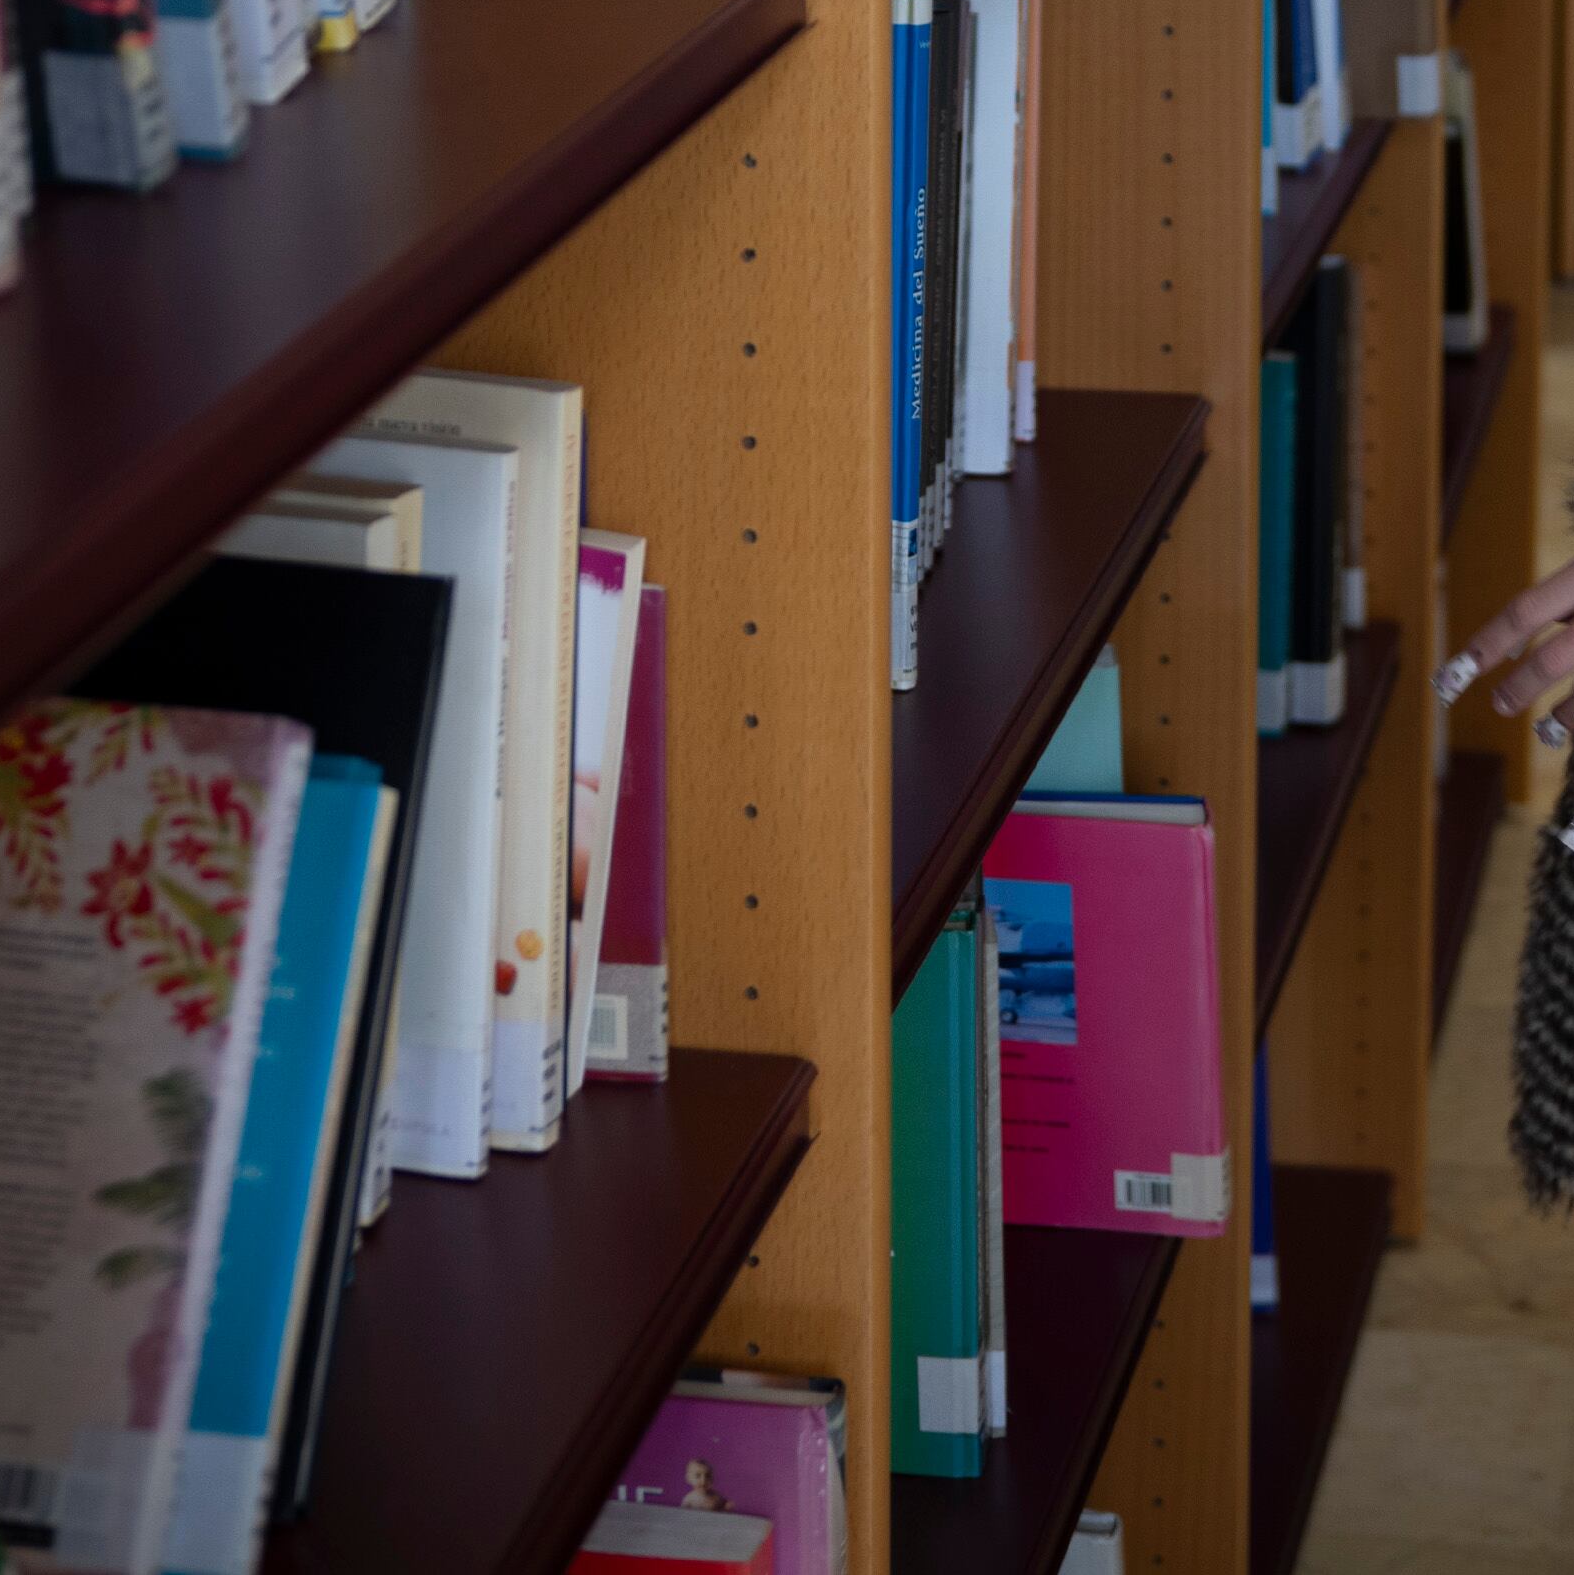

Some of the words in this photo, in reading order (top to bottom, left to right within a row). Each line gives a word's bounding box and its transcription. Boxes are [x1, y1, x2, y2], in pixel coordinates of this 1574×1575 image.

[913, 187, 926, 260] Sueño
[912, 270, 924, 305] del
[911, 315, 924, 419] Medicina
